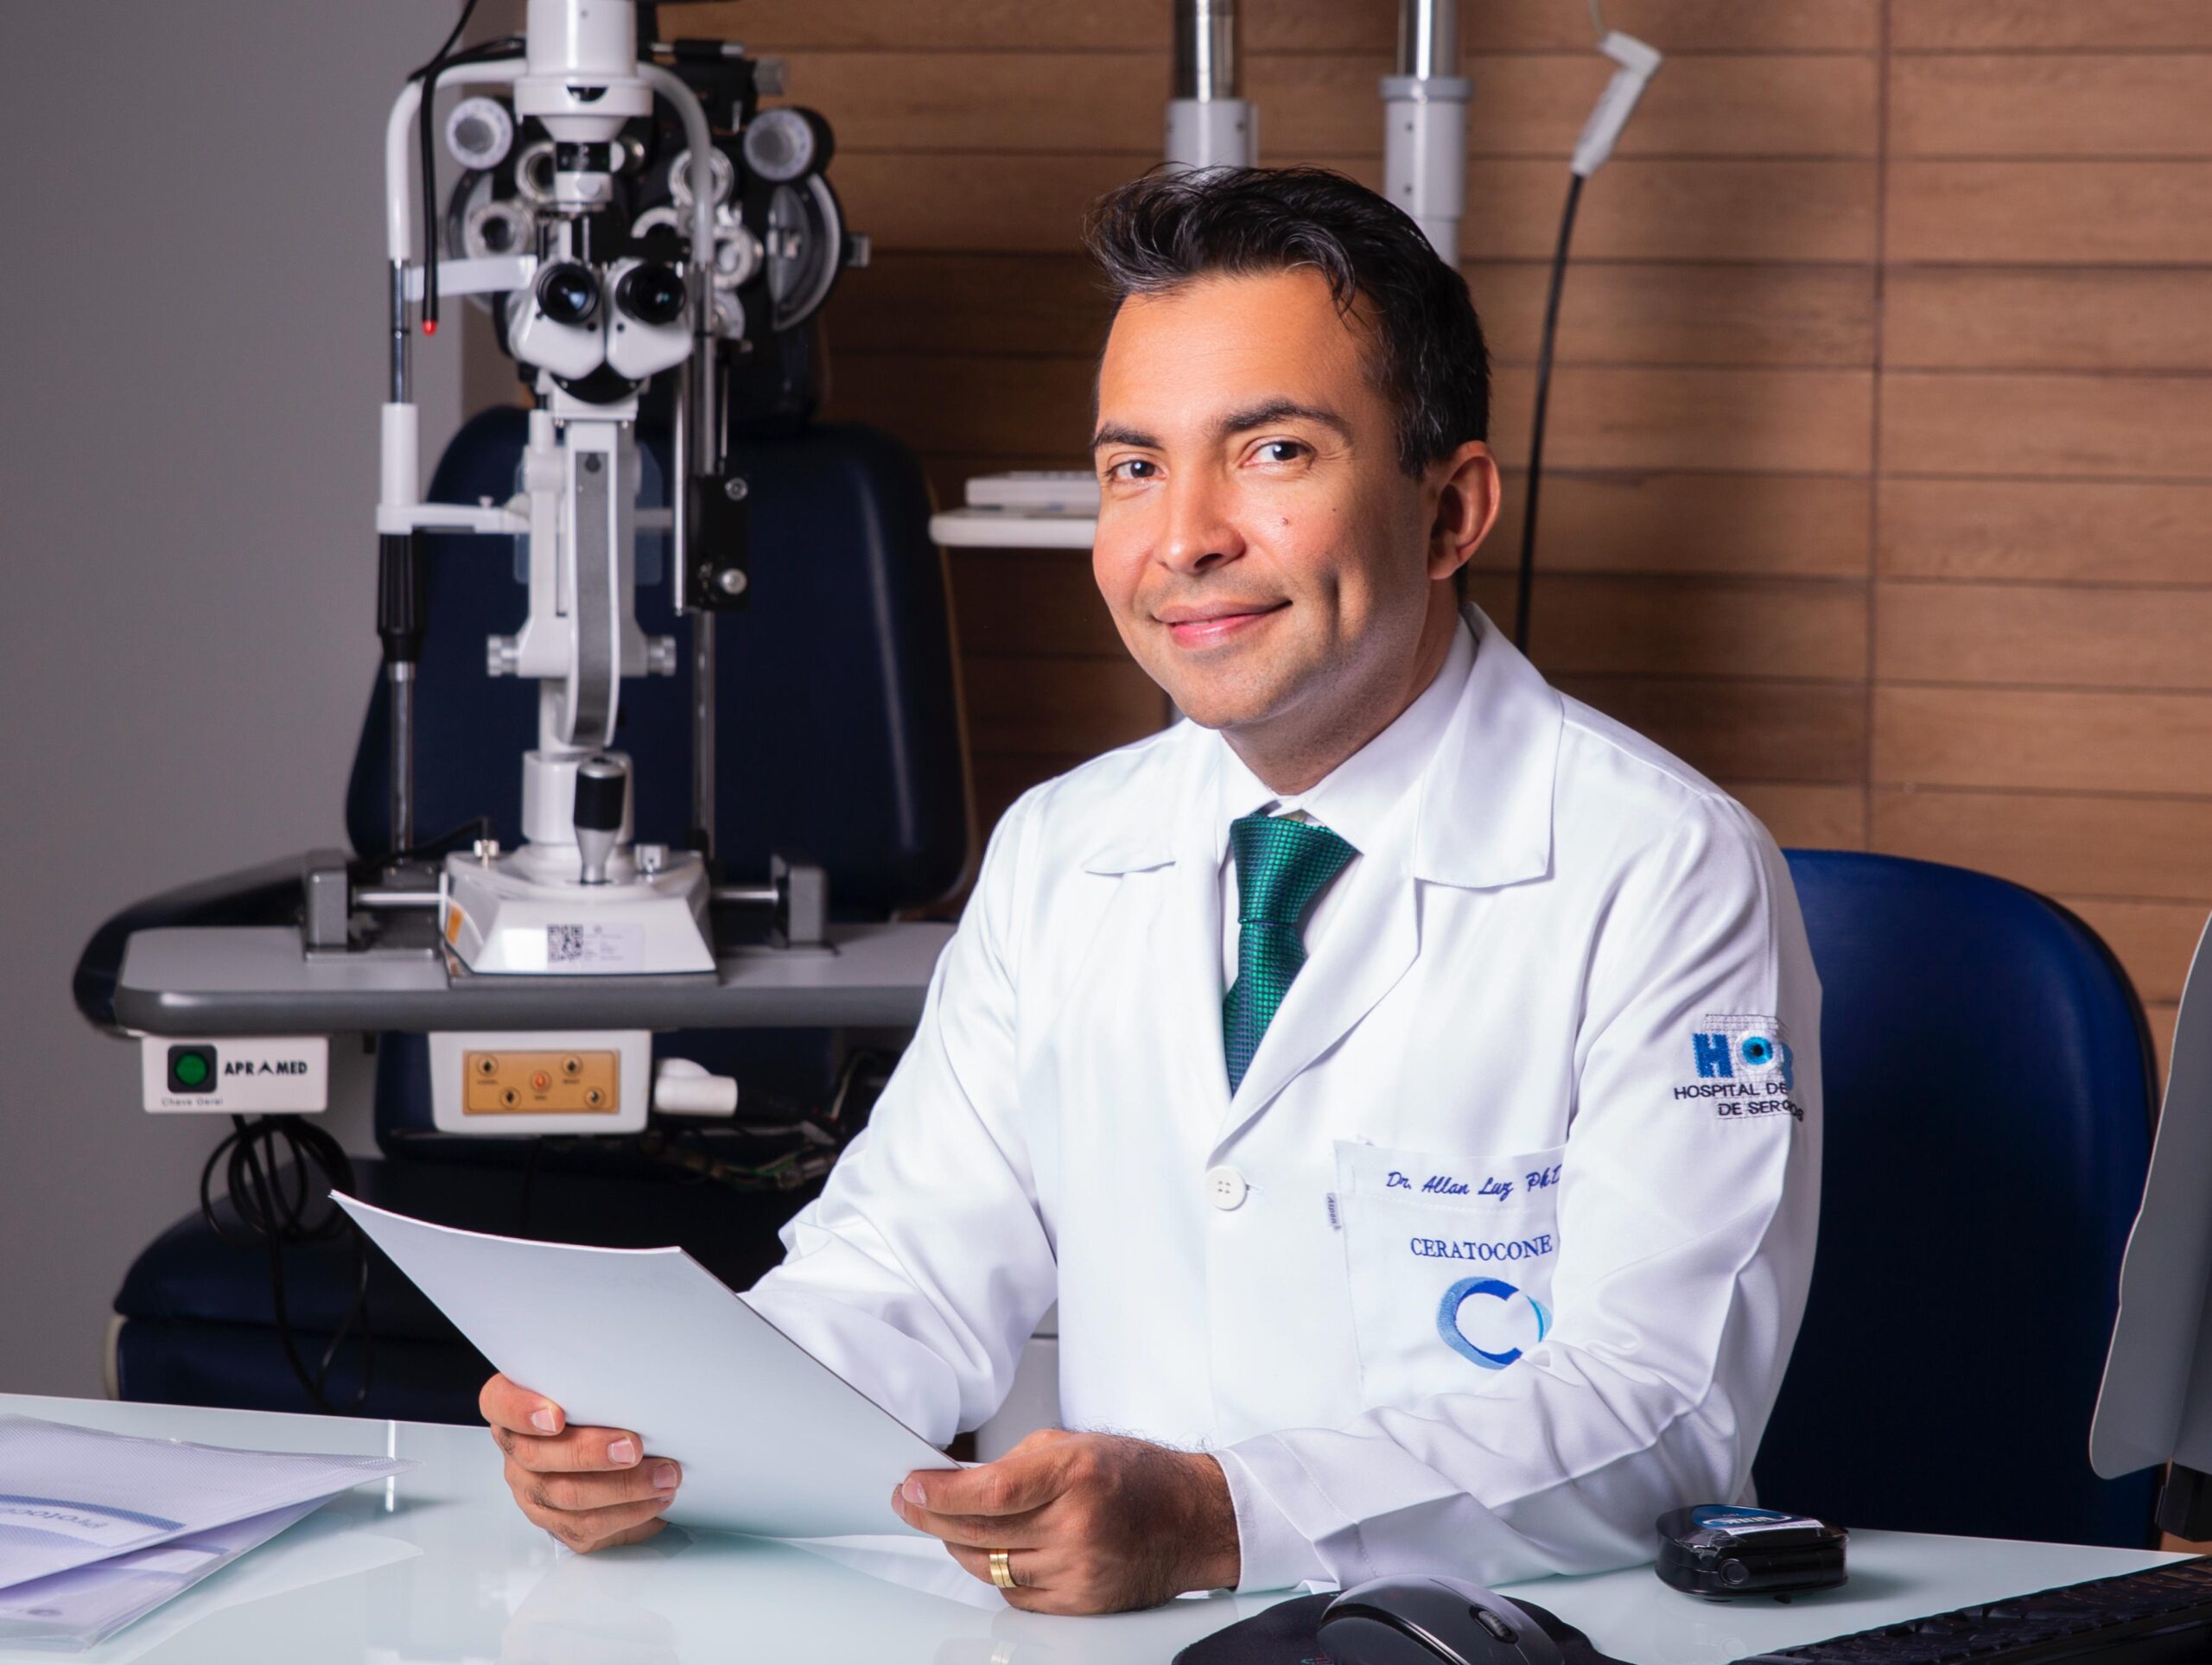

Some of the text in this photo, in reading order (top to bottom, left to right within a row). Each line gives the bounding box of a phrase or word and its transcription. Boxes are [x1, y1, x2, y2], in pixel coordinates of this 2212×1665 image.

[224, 1061, 308, 1075] APRAMED
[1674, 1084, 1760, 1100] HOSPITAL
[1718, 1102, 1743, 1116] DE
[1385, 1171, 1412, 1190] Dr.
[1421, 1175, 1470, 1196] Allan
[1478, 1177, 1514, 1202] Luz
[1410, 1234, 1554, 1261] CERATOCONE
